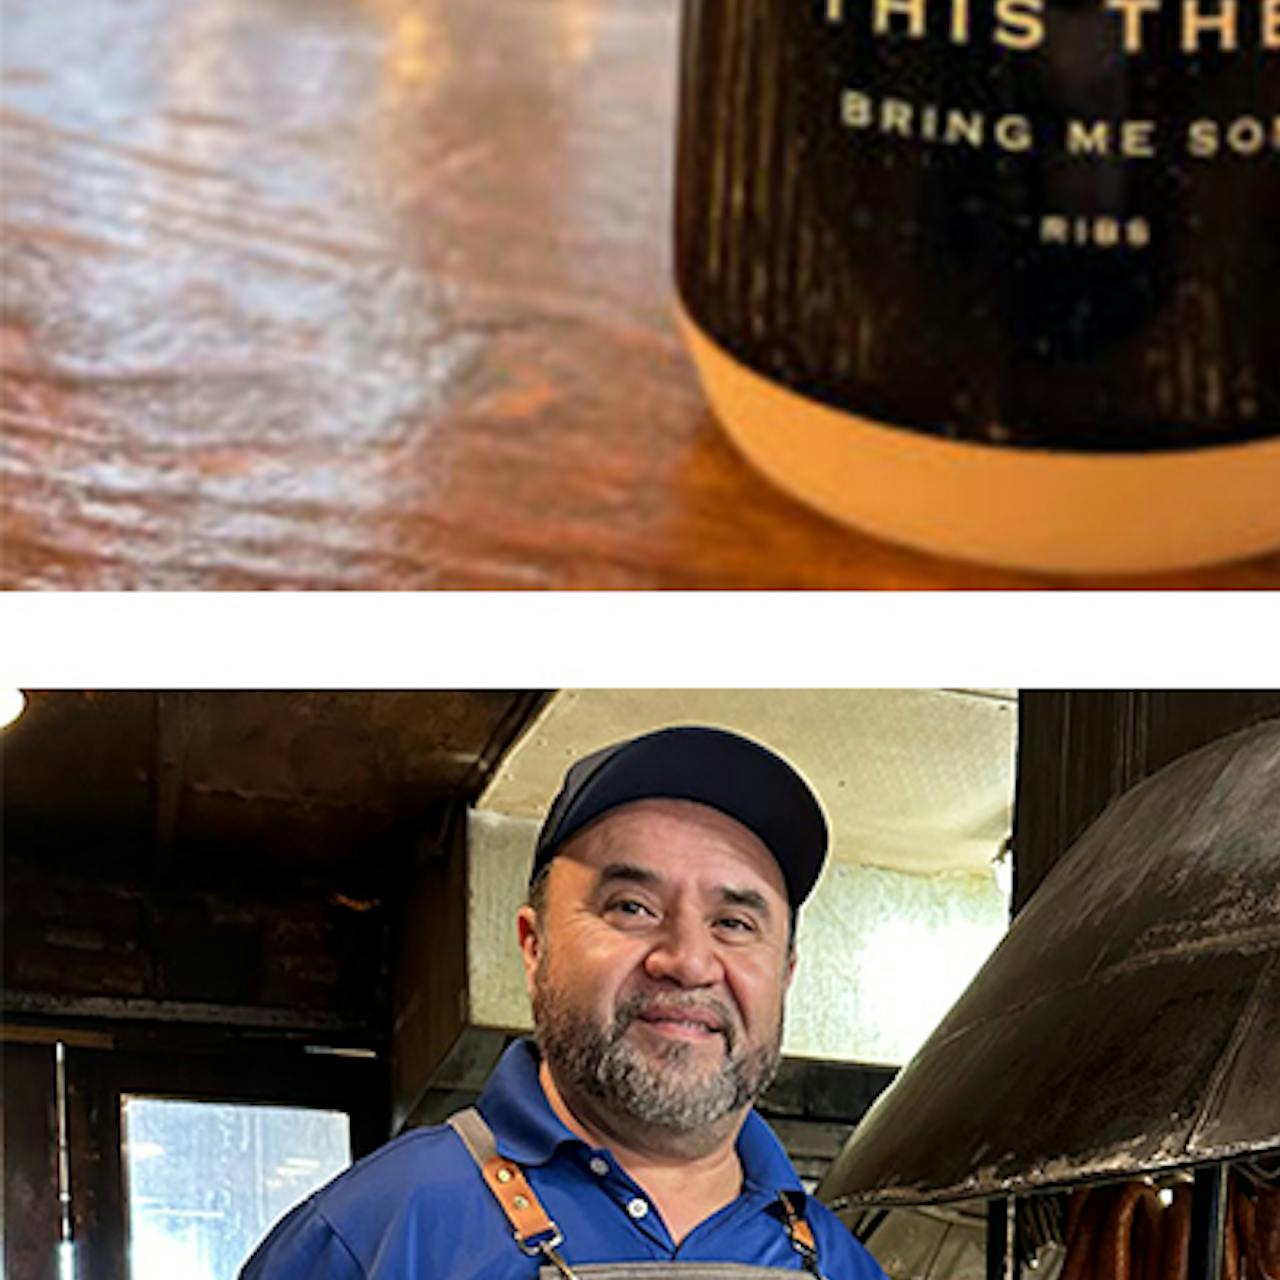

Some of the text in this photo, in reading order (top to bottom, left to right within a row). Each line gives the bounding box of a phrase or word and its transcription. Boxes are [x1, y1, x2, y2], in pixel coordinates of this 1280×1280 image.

[839, 89, 1033, 153] BRING
[1066, 120, 1156, 158] ME
[1040, 215, 1150, 247] RIBS
